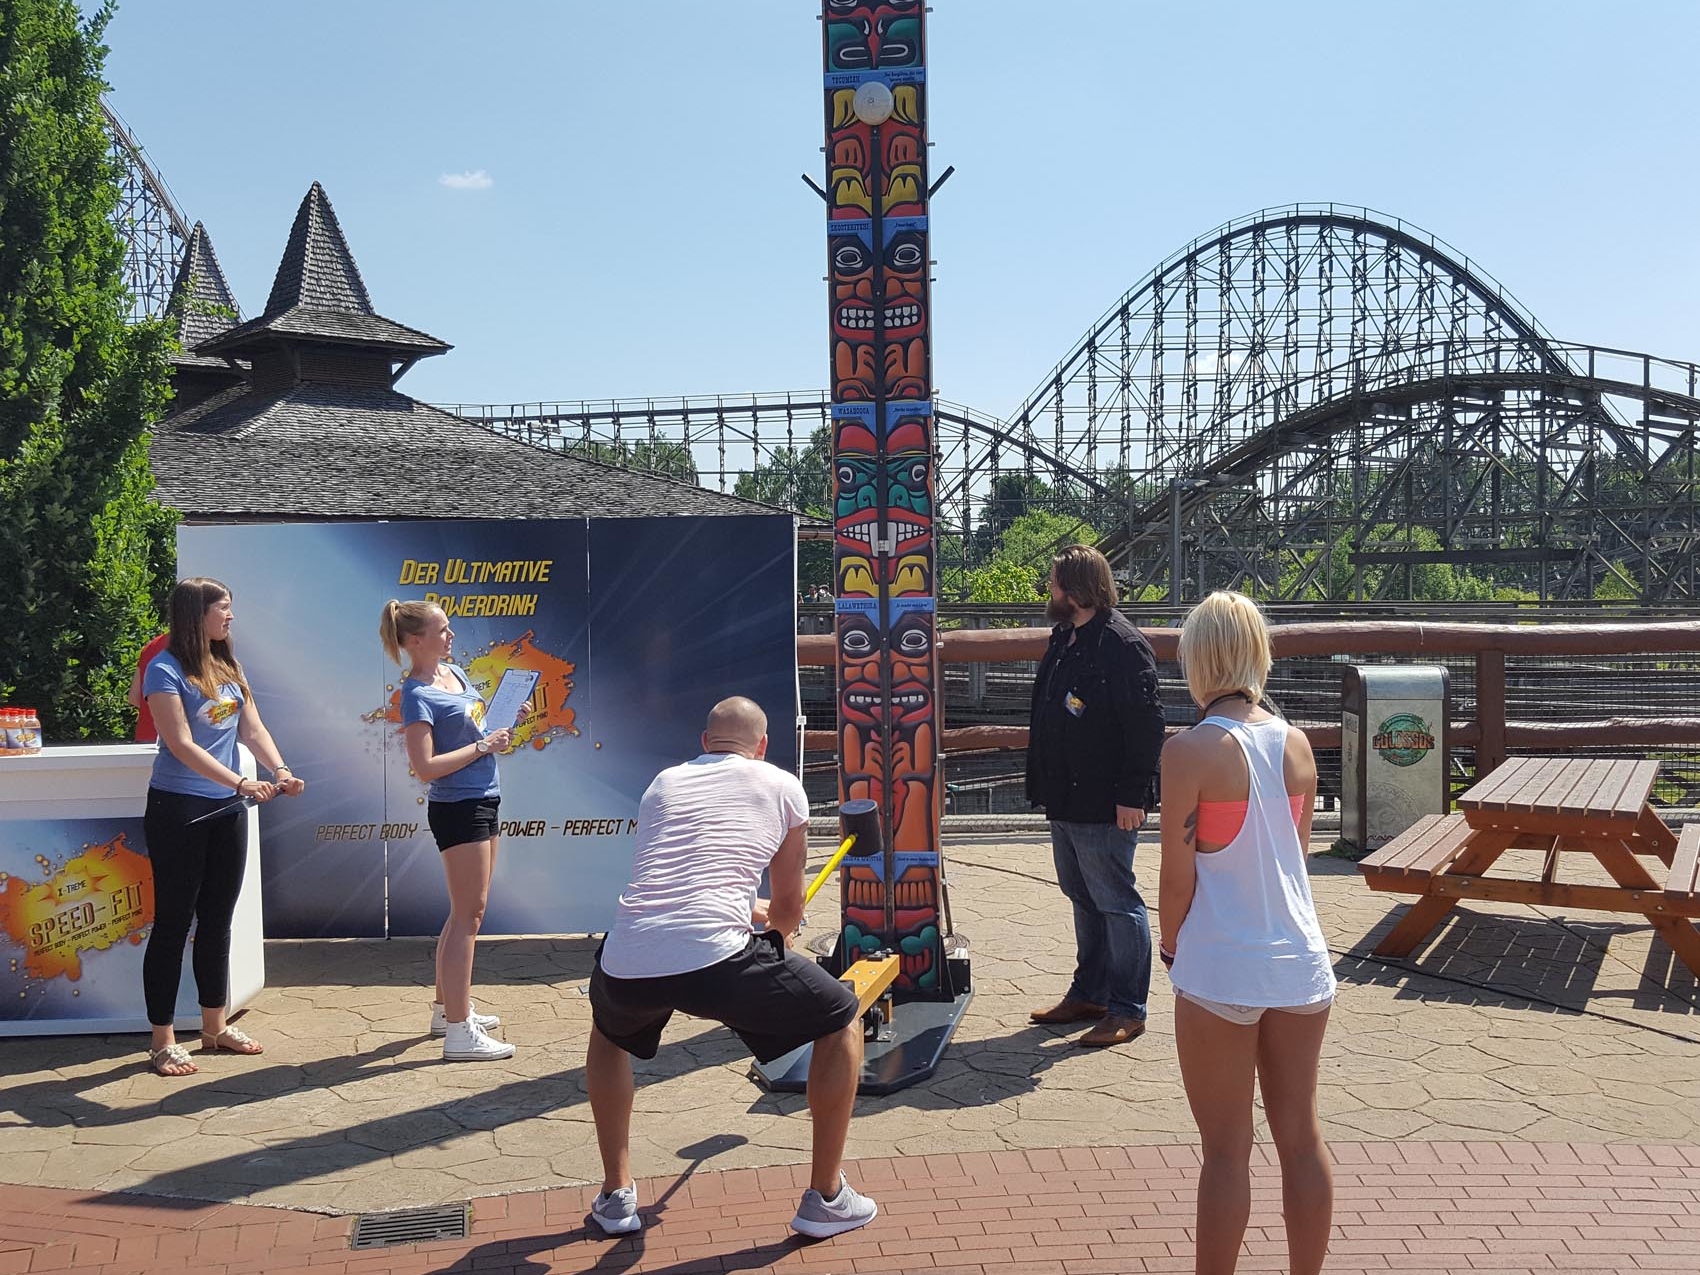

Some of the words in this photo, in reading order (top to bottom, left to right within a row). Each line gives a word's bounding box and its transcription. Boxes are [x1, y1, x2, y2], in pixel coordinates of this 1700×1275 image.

[399, 559, 440, 585] DER
[443, 558, 553, 584] ULTIMATIVE
[316, 824, 376, 841] PERFECT
[380, 823, 418, 840] BODY
[498, 820, 546, 837] POWER
[563, 819, 624, 836] PERFECT
[57, 879, 87, 897] X-TREME
[71, 929, 91, 942] PERFECT
[91, 922, 106, 934] POWER
[111, 913, 131, 925] PERFECT
